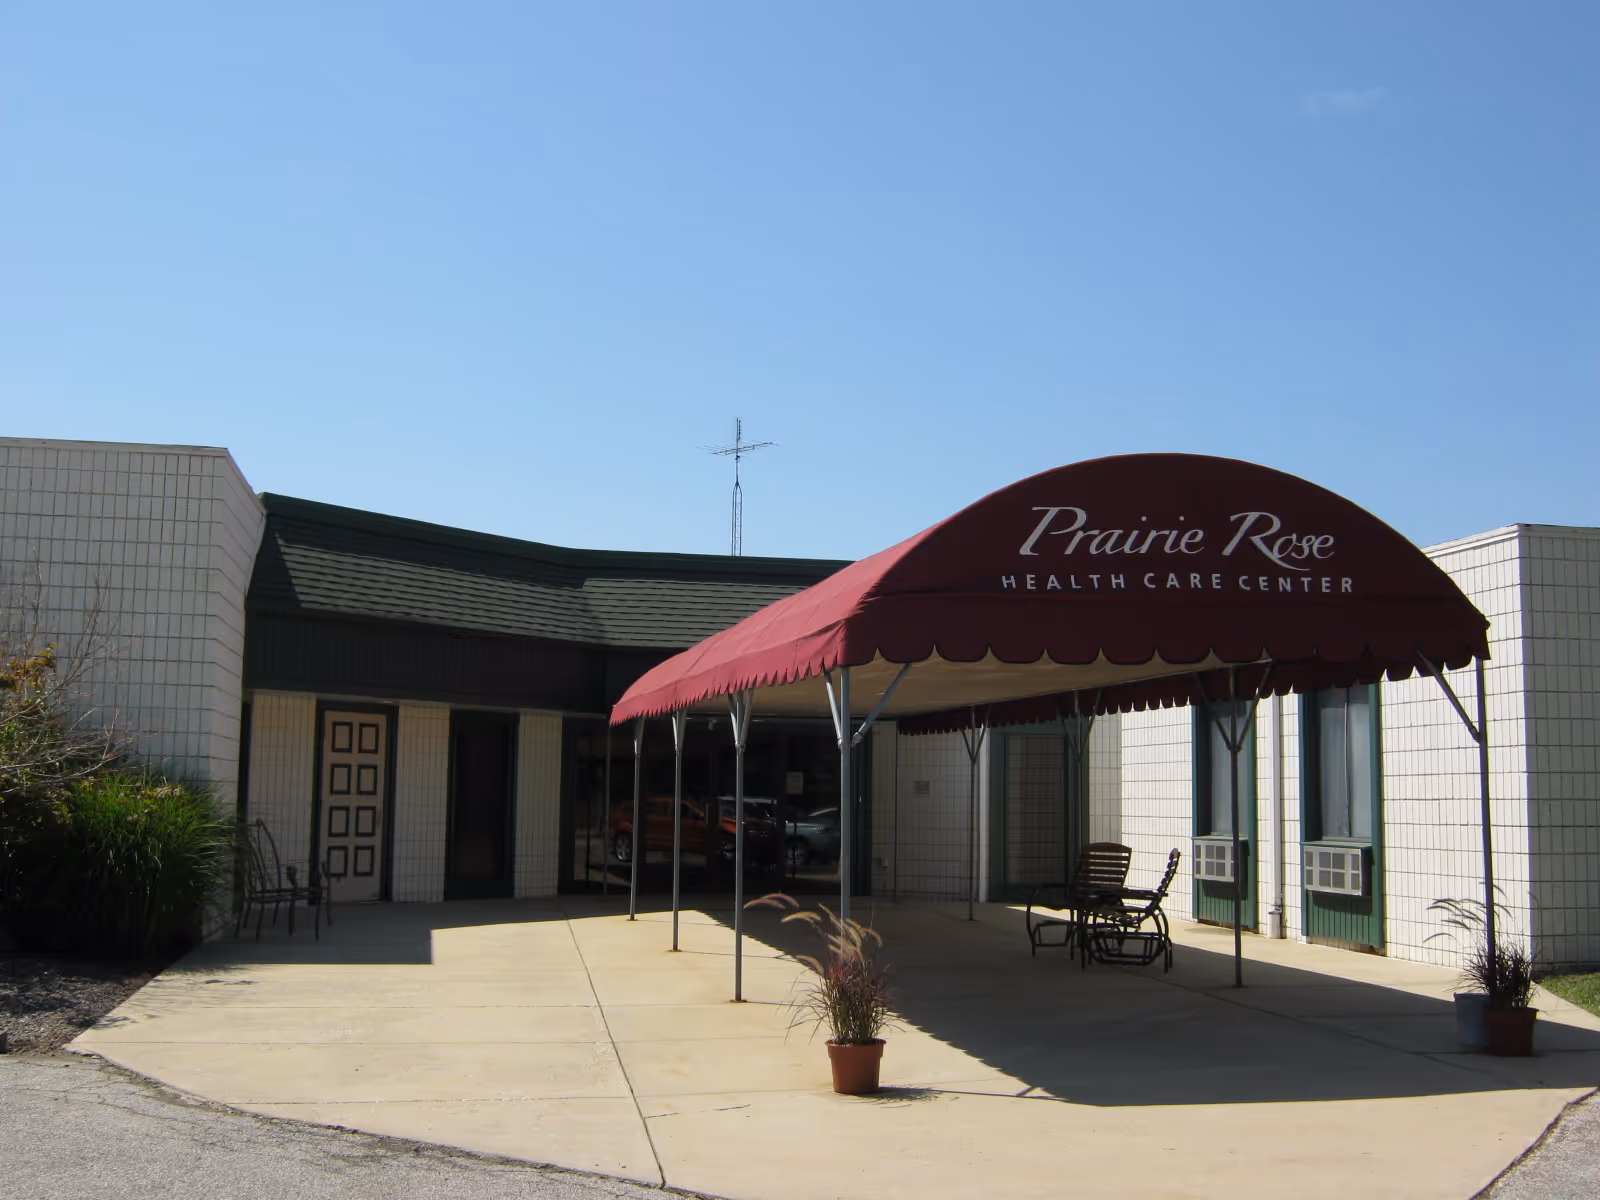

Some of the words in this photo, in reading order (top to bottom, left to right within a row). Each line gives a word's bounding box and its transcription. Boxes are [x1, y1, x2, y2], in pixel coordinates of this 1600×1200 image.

[1019, 506, 1205, 556] Prairie
[1221, 511, 1336, 571] Rose
[1001, 574, 1126, 590] HEALTH
[1143, 572, 1222, 589] CARE
[1238, 575, 1354, 593] CENTER
